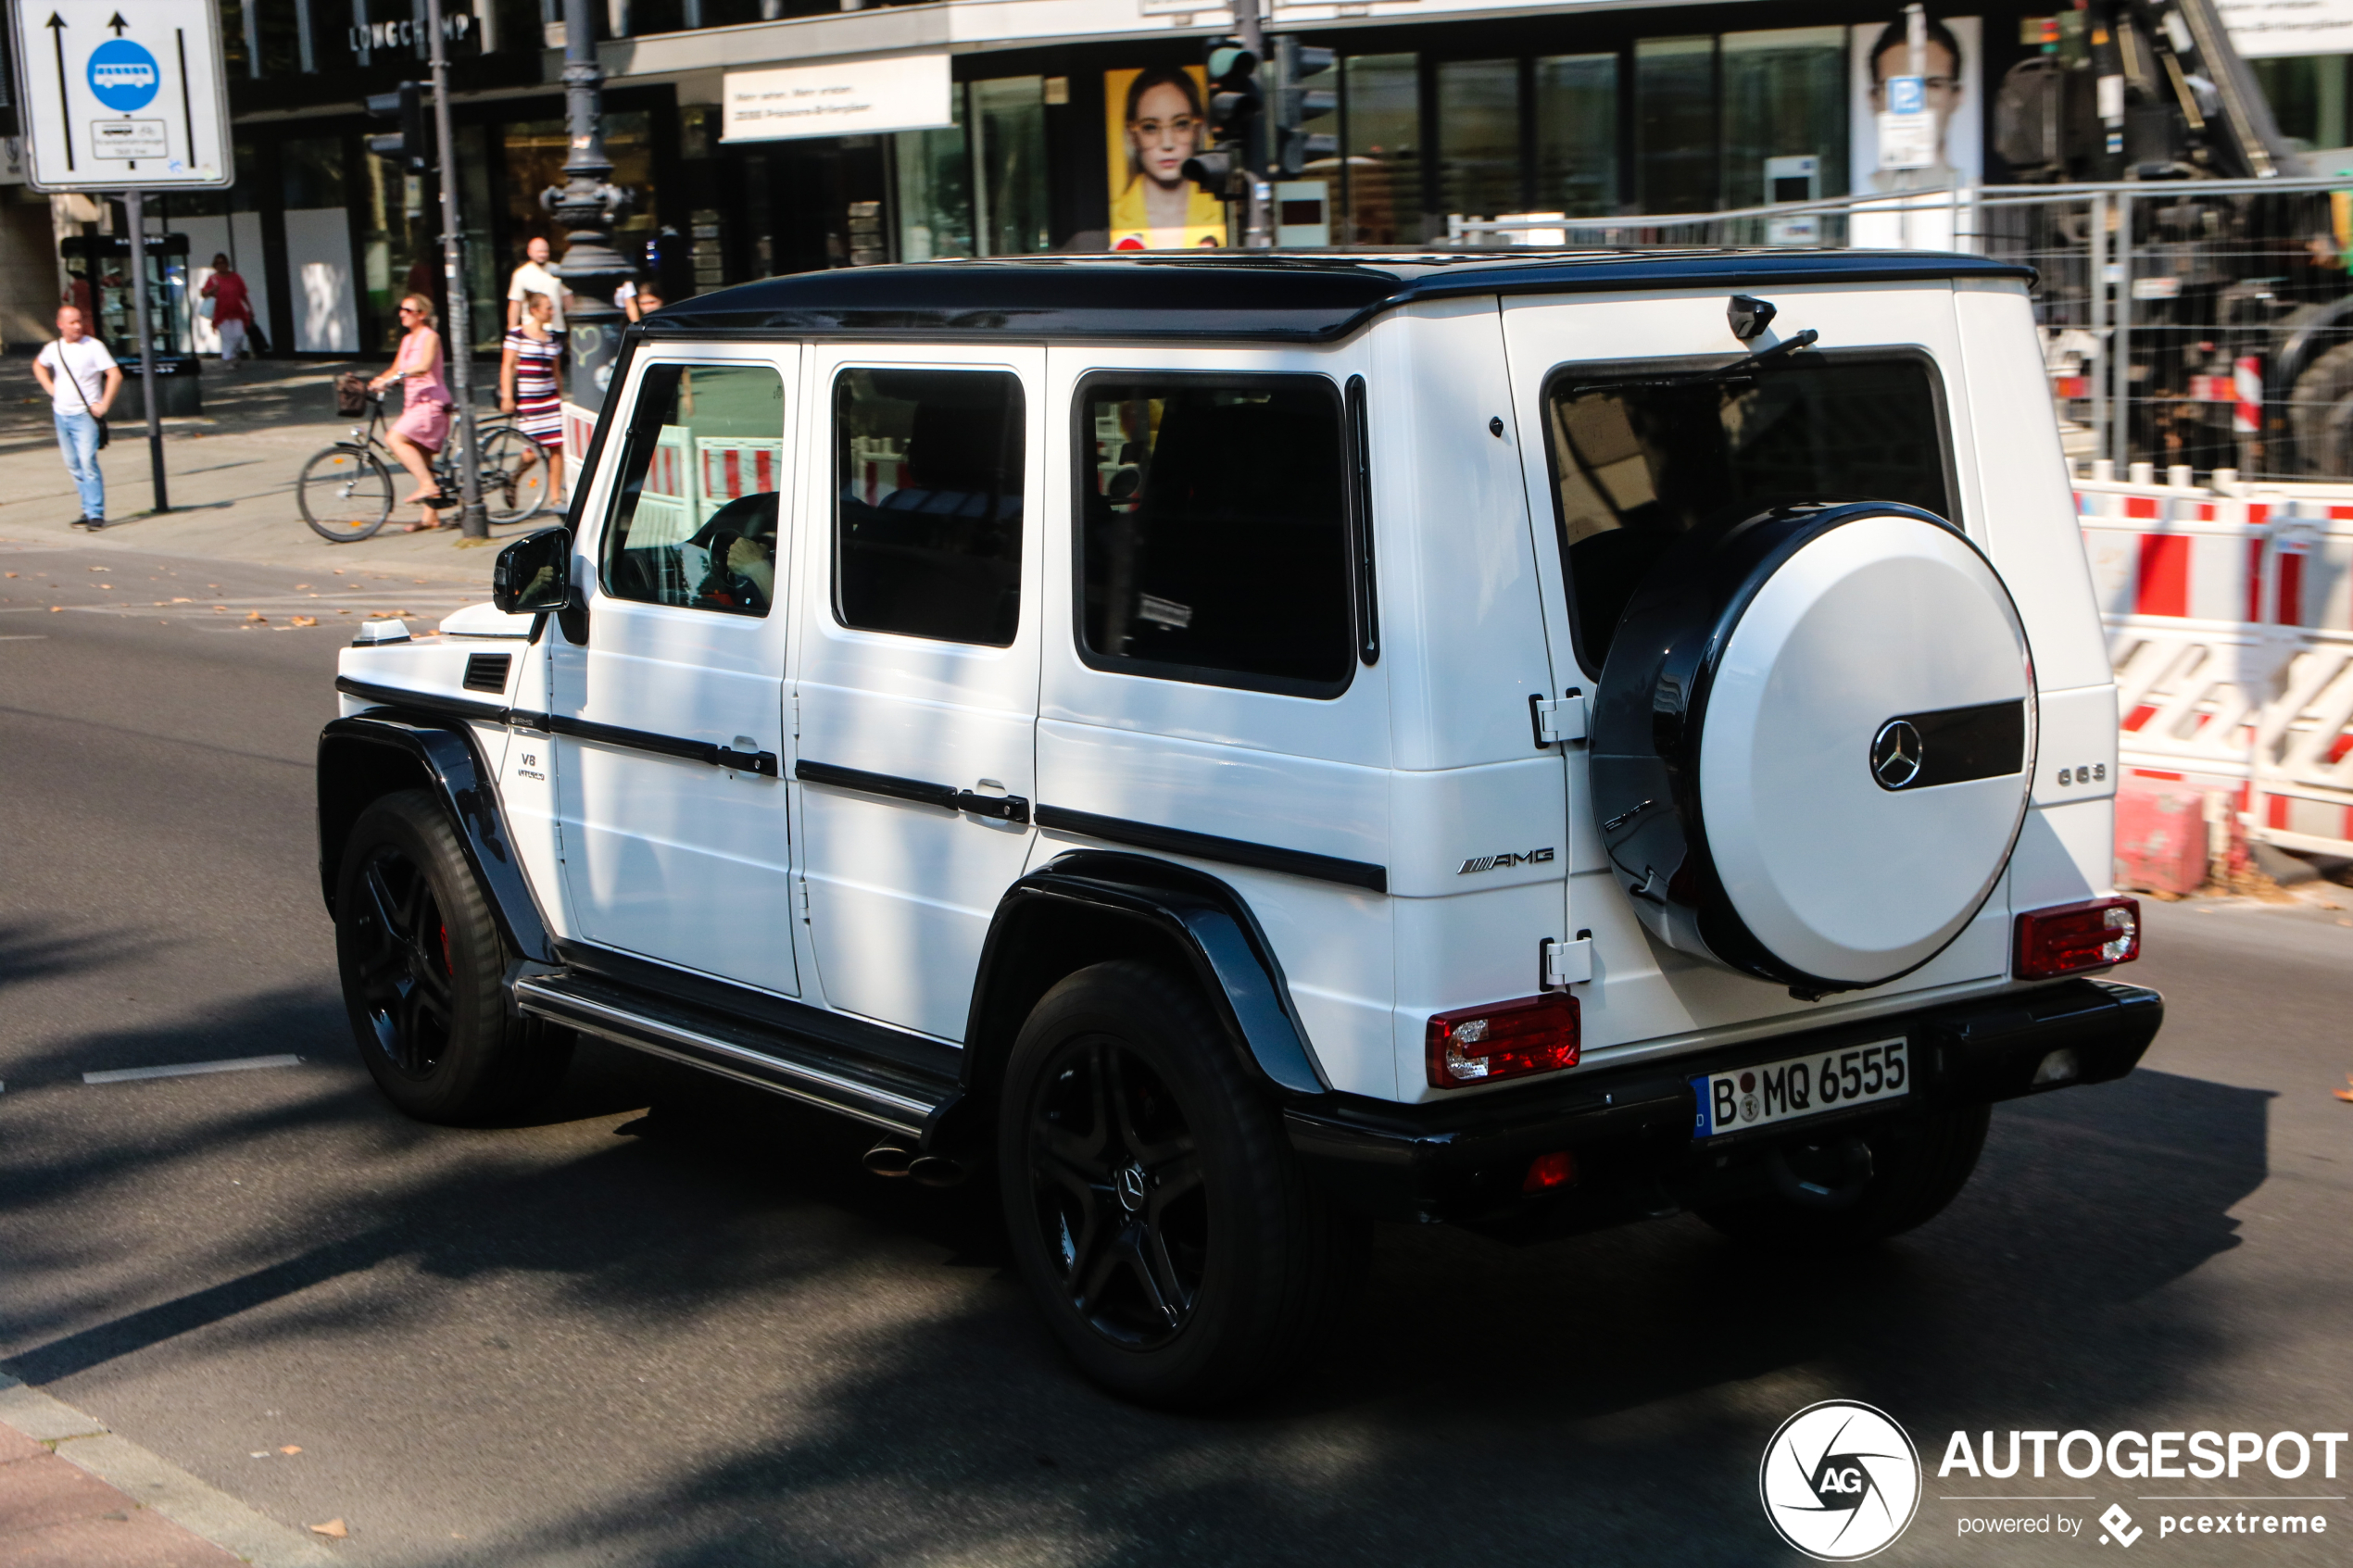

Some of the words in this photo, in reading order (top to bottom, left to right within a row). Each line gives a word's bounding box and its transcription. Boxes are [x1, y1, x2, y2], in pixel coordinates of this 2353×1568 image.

[348, 13, 470, 52] LONGCHMP
[1489, 847, 1554, 870] AMG
[1713, 1078, 1737, 1127] B
[1762, 1062, 1811, 1117] MQ
[1818, 1042, 1906, 1104] 6555
[1696, 1113, 1705, 1127] D
